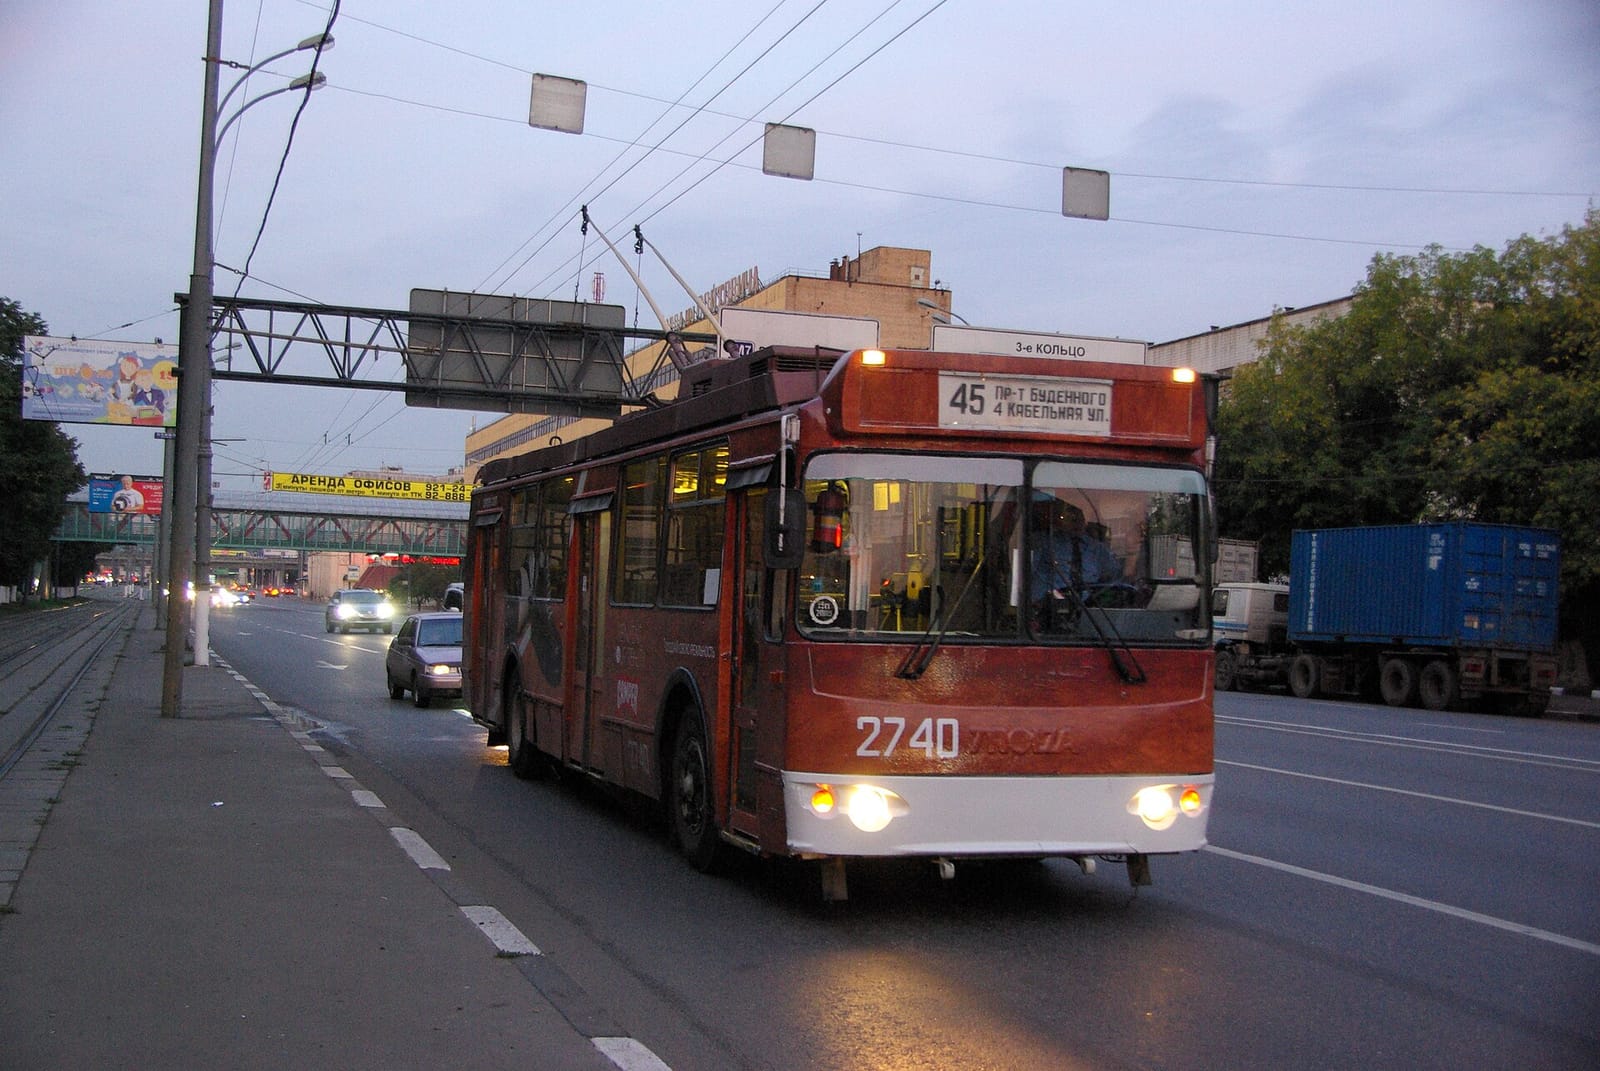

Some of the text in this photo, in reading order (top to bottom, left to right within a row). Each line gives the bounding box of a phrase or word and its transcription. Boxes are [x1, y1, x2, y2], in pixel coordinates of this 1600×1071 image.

[1015, 341, 1086, 358] 3-е КОЛЬЦО
[950, 383, 985, 415] 45
[995, 385, 1107, 406] ПР-Т БУДЕННОГО
[993, 403, 1109, 422] 4 КАБЕЛЬНАЯ УЛ.
[291, 474, 411, 491] АРЕНДА ОФИСОВ
[425, 483, 476, 492] 921-24-
[856, 716, 959, 758] 2740
